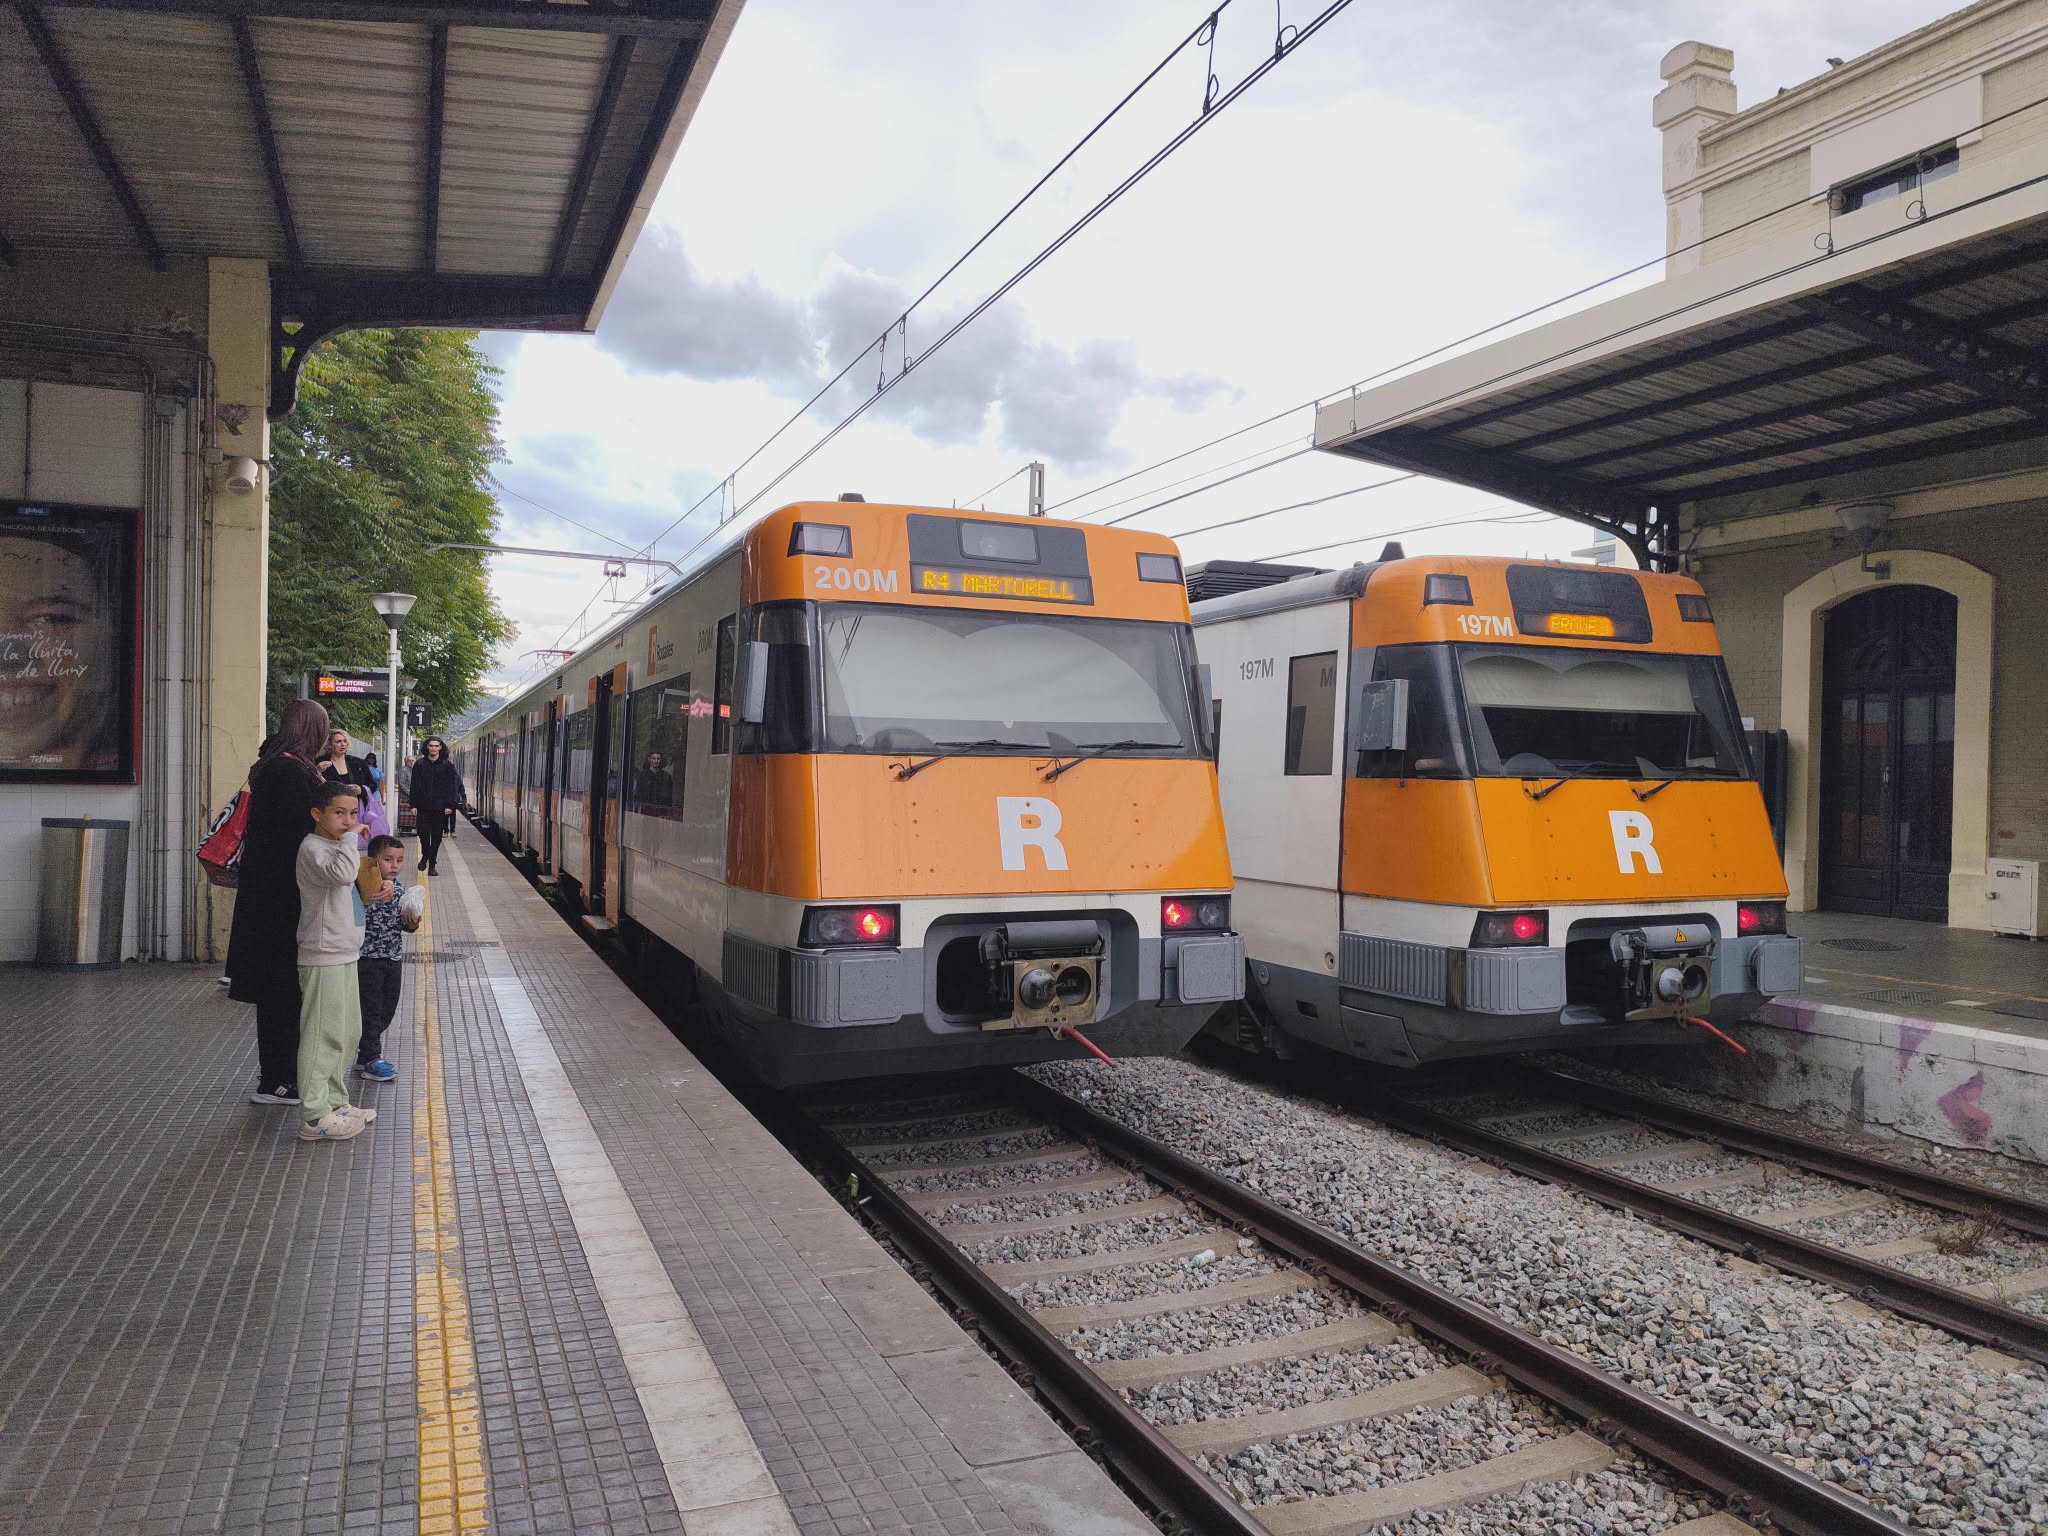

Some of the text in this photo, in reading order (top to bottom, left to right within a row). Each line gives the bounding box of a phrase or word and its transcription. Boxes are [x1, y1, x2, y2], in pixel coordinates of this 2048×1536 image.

[814, 566, 898, 593] 200M
[923, 570, 1074, 600] R4 MARTORELL
[1457, 614, 1514, 637] 197M
[3, 643, 20, 661] la
[16, 660, 39, 679] de
[1240, 658, 1274, 680] 197M
[319, 680, 335, 689] R4
[415, 712, 423, 725] 1
[996, 796, 1069, 870] R
[1608, 810, 1663, 873] R
